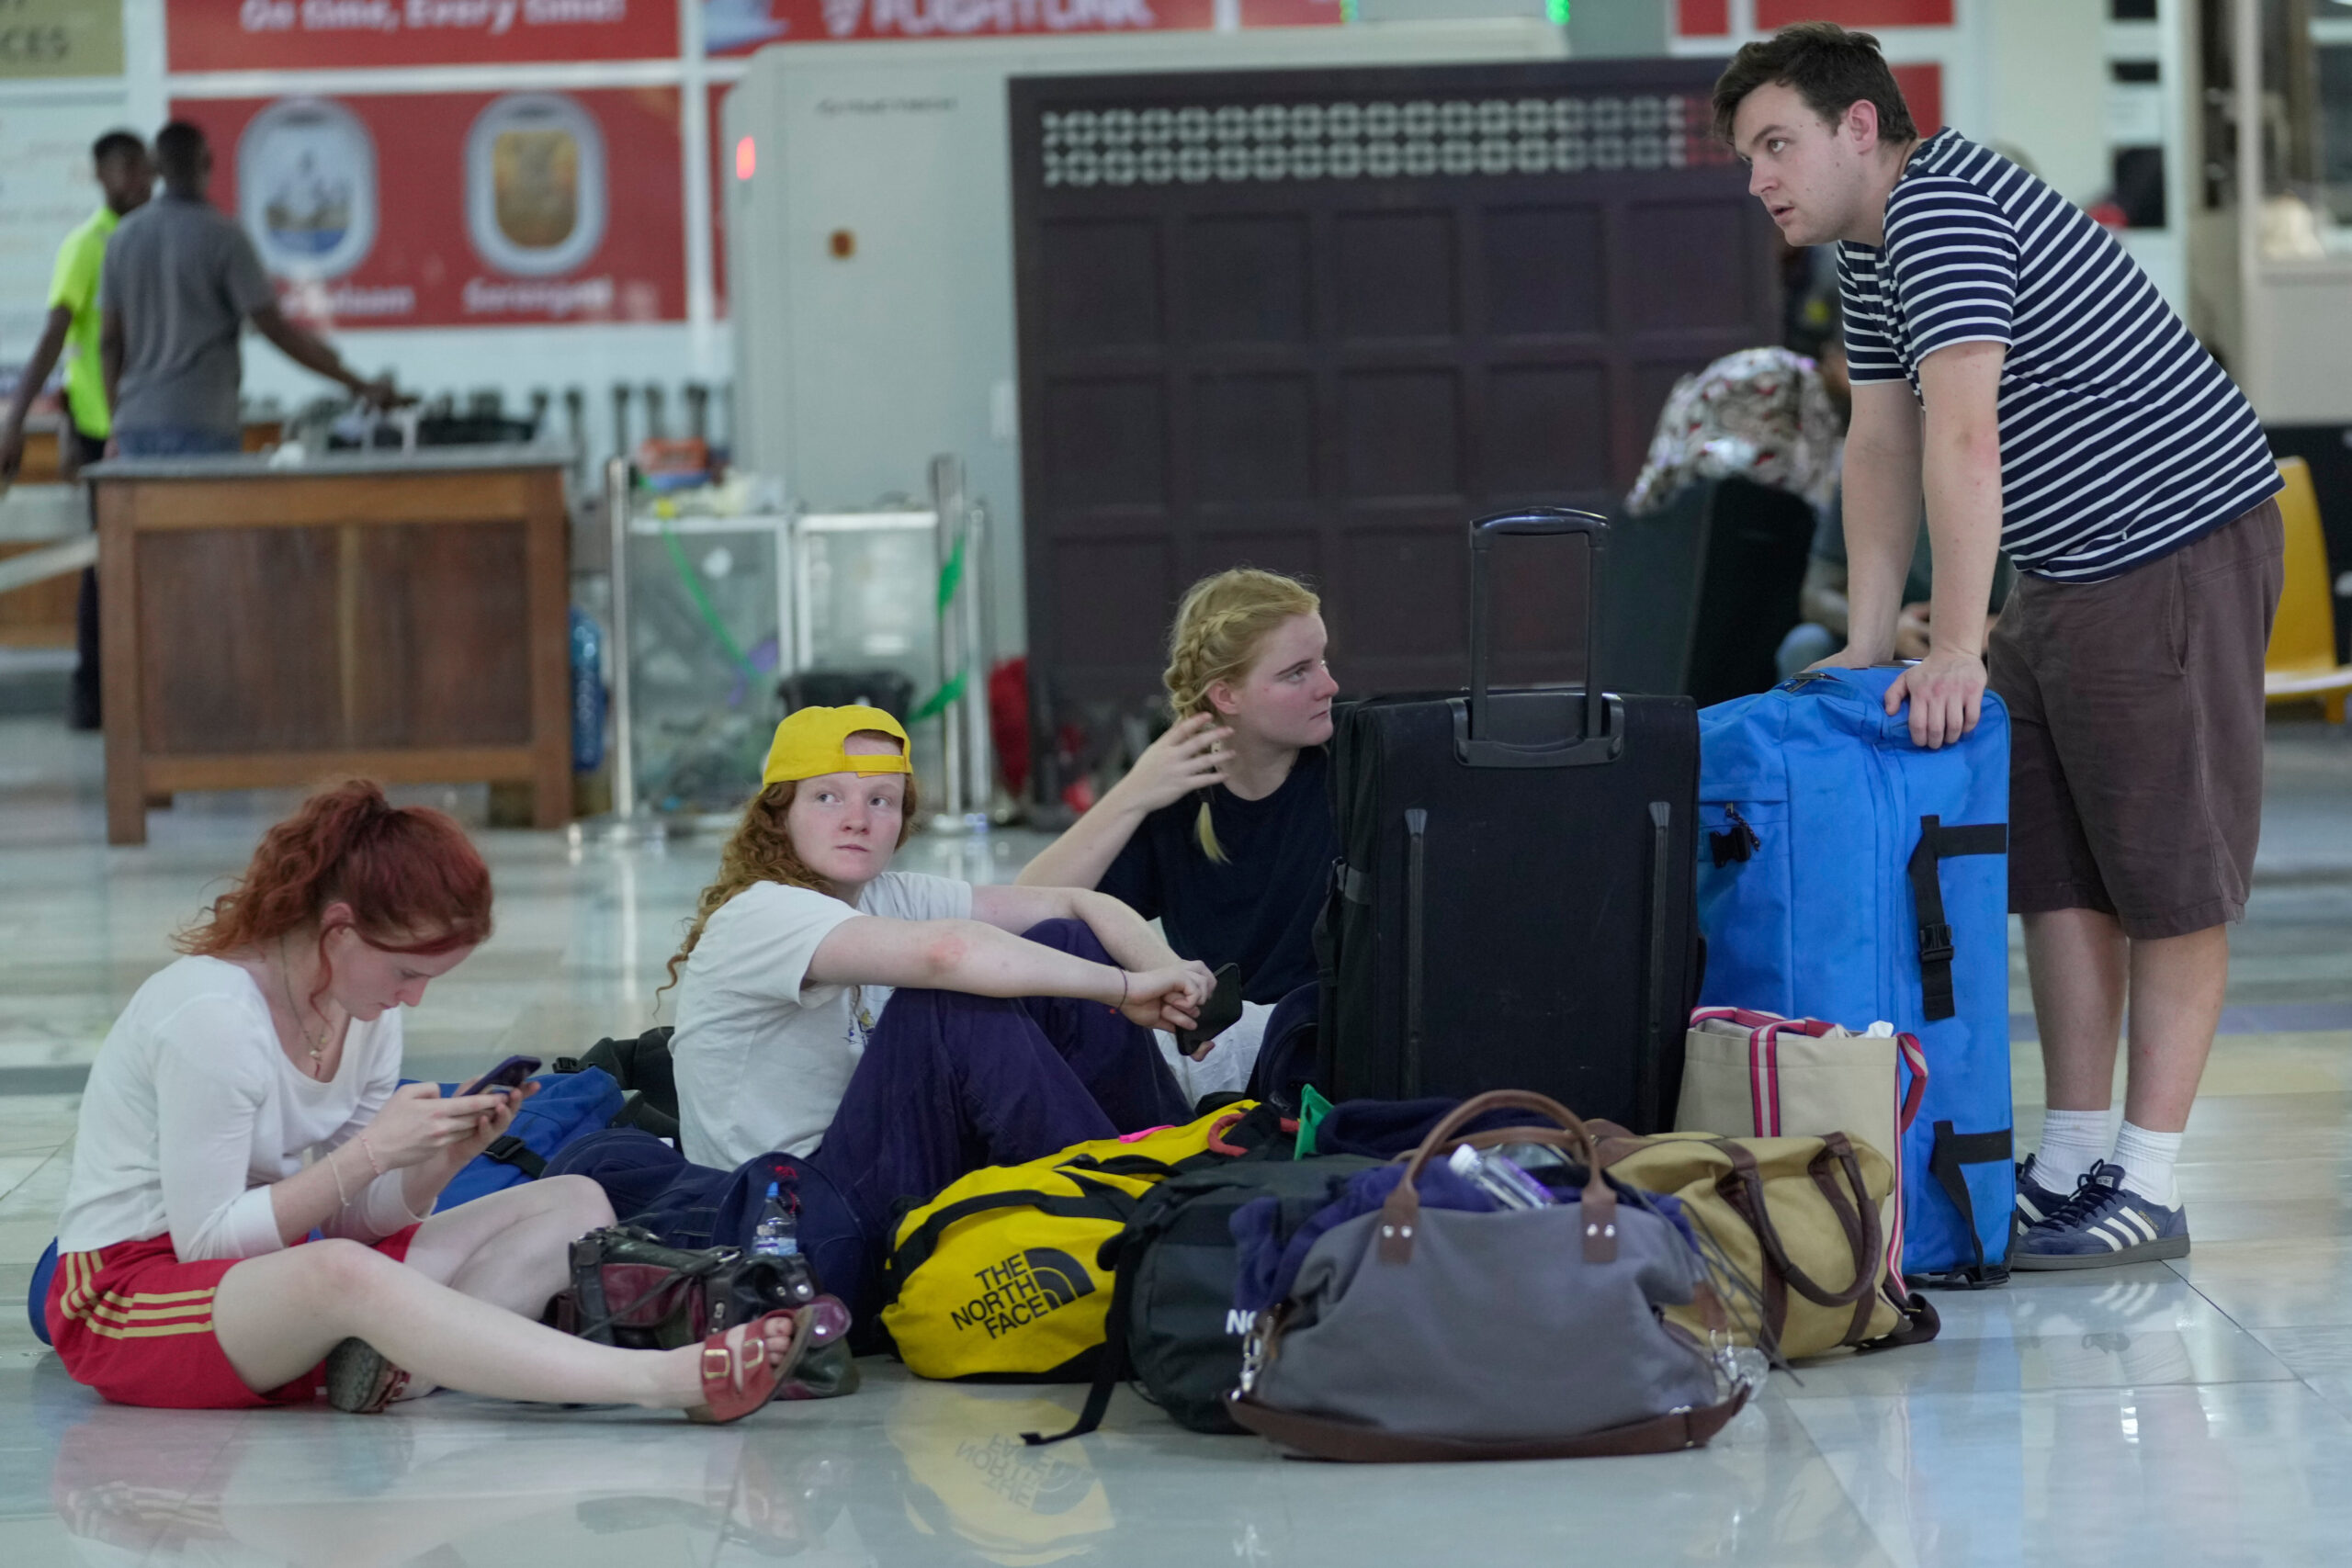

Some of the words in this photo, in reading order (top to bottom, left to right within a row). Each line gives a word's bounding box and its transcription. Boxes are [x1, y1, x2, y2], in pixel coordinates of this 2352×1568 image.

[974, 1253, 1028, 1291] THE
[950, 1273, 1038, 1331] NORTH
[983, 1294, 1049, 1339] FACE
